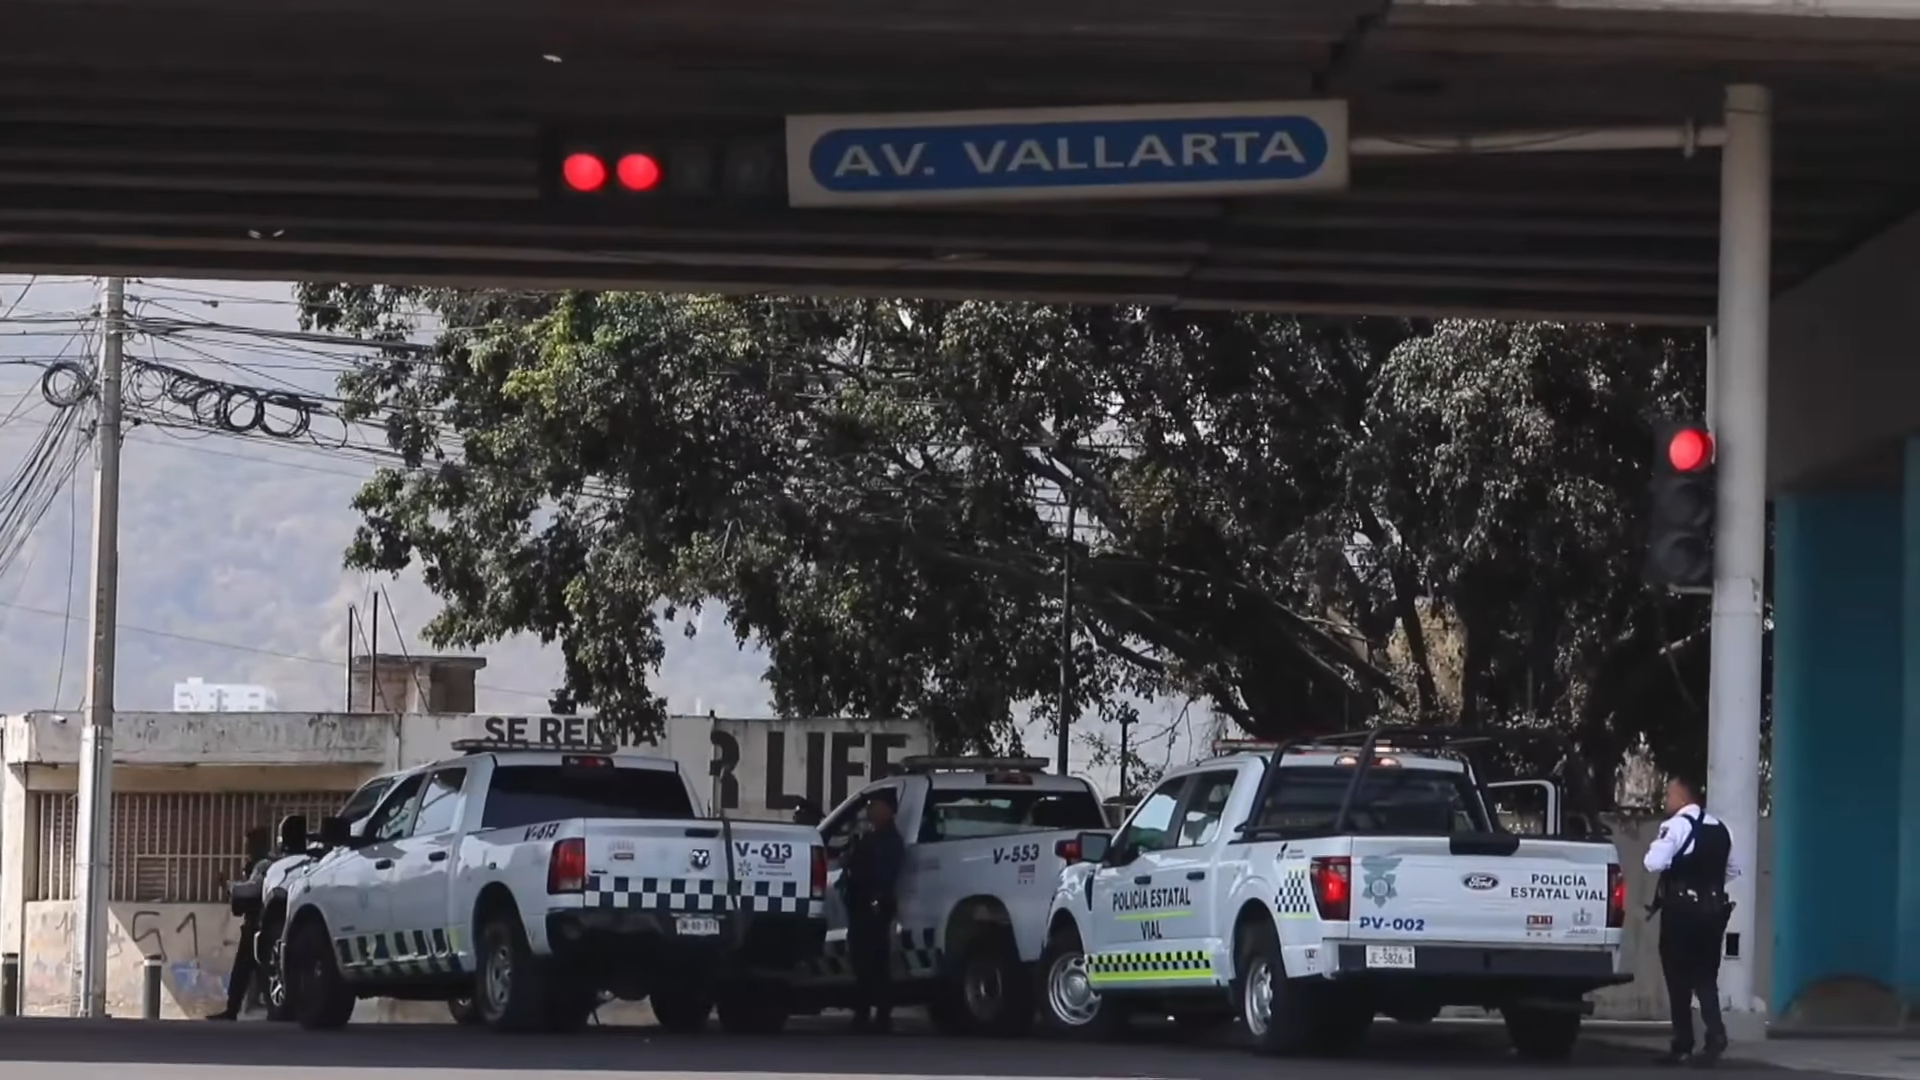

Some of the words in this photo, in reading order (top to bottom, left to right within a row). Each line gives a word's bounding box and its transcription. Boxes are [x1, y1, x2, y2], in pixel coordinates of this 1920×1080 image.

[833, 142, 934, 177] AV.
[962, 130, 1306, 174] VALLARTA
[484, 716, 528, 743] SE
[734, 841, 793, 859] V-613
[992, 843, 1040, 865] V-553
[1531, 872, 1588, 887] POLICÍA
[1150, 886, 1191, 908] ESTATAL
[1510, 886, 1571, 900] ESTATAL
[1575, 889, 1608, 901] VIAL
[1140, 920, 1162, 941] VIAL
[1359, 916, 1425, 932] PV-002
